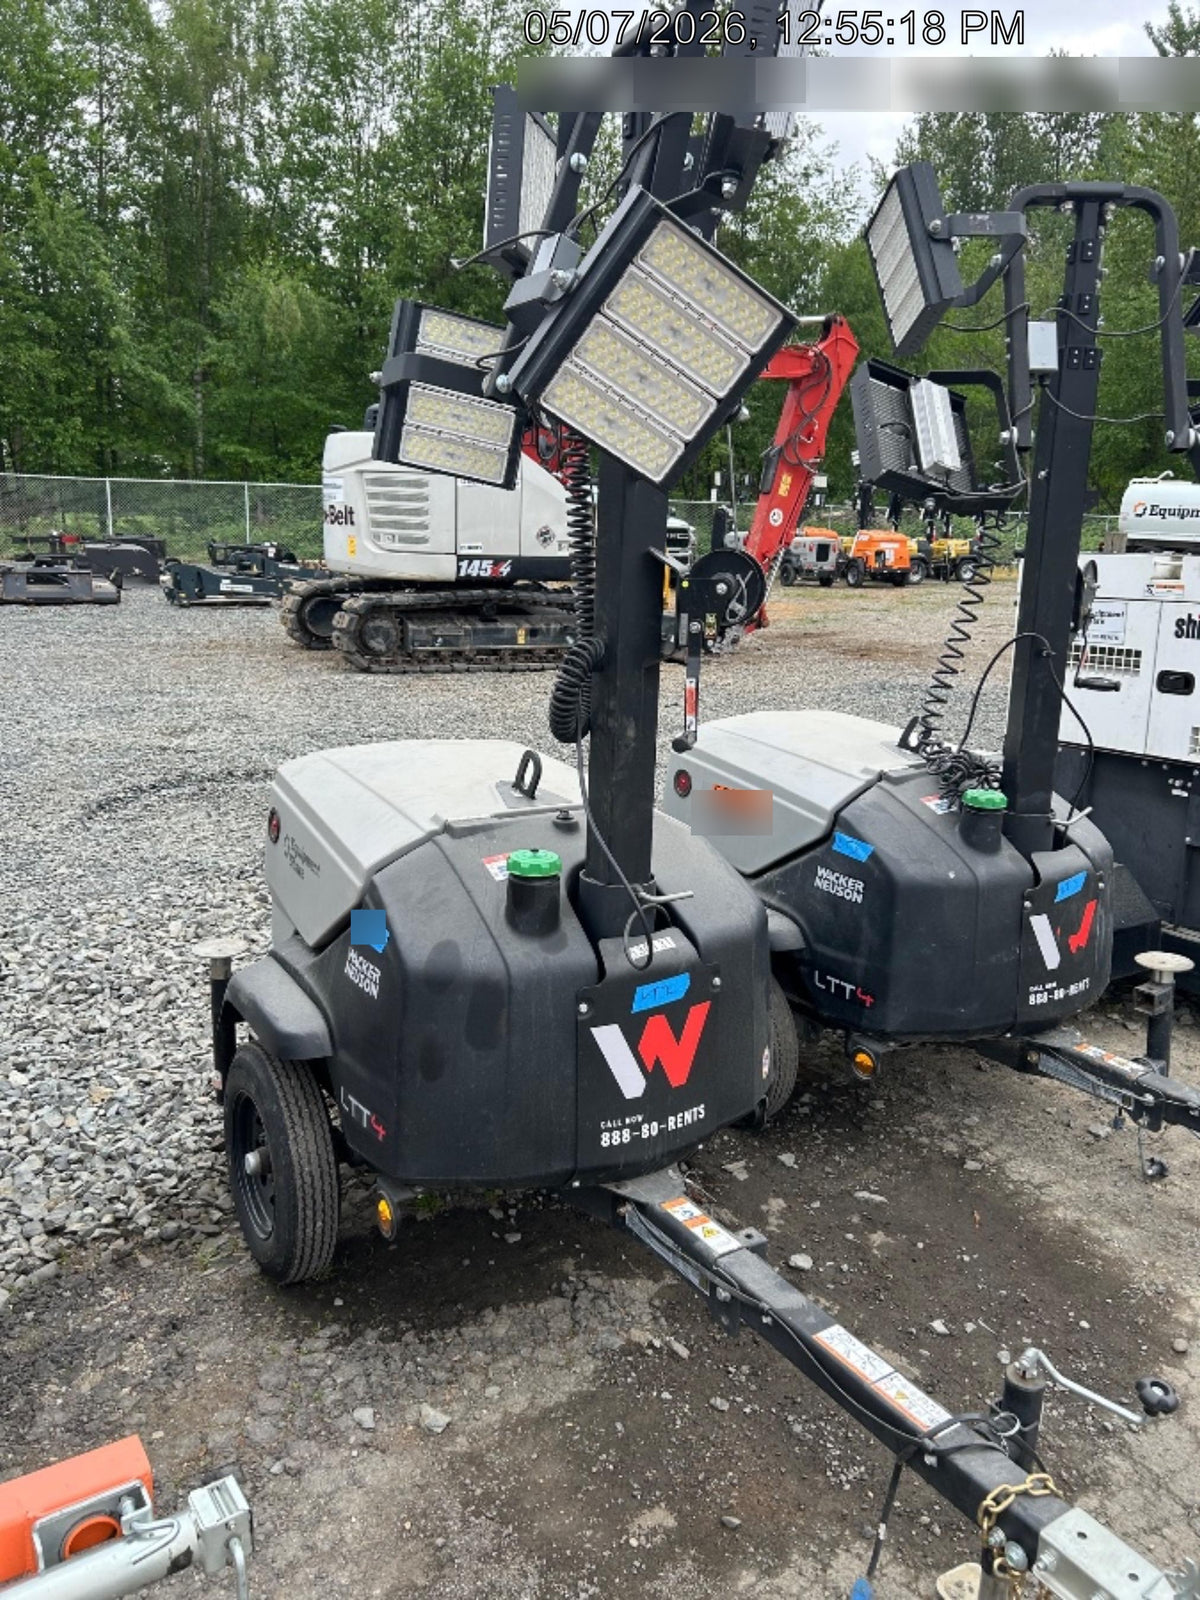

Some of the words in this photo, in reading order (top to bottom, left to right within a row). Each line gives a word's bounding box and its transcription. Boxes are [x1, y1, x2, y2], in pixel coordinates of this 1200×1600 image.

[813, 877, 864, 904] NEUSON
[817, 865, 865, 893] WACKER
[814, 970, 876, 1008] LTT4
[340, 1086, 387, 1143] LTT4
[600, 1119, 623, 1130] CALL
[625, 1114, 644, 1125] NOW
[600, 1103, 705, 1148] 888-80-RENTS
